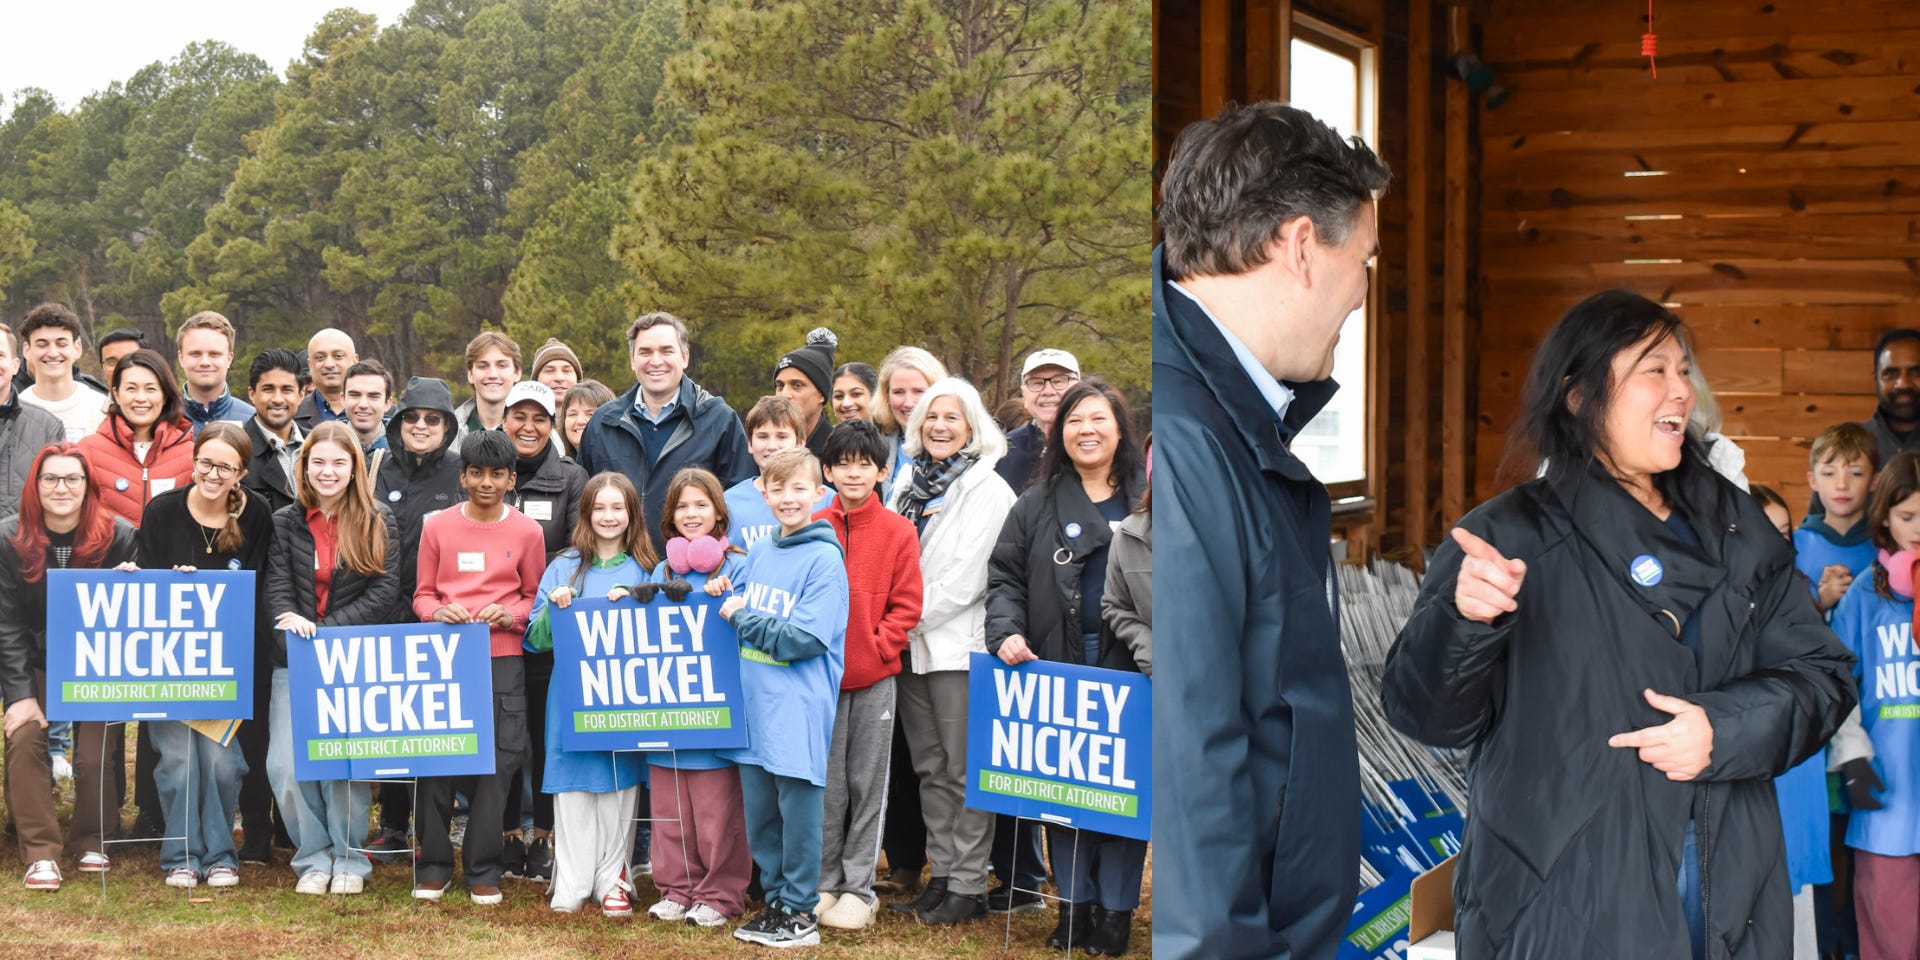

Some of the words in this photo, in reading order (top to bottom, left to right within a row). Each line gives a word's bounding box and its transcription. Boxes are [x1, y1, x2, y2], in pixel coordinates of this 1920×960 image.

[75, 583, 226, 628] WILEY
[574, 604, 708, 657] WILEY
[75, 631, 234, 677] NICKEL
[313, 633, 461, 685] WILEY
[73, 684, 99, 699] FOR
[102, 683, 158, 699] DISTRICT
[160, 683, 226, 698] ATTORNEY
[580, 655, 726, 706] NICKEL
[993, 668, 1130, 734] WILEY
[316, 682, 474, 734] NICKEL
[584, 714, 607, 729] FOR
[609, 712, 657, 728] DISTRICT
[660, 710, 720, 727] ATTORNEY
[319, 741, 342, 757] FOR
[346, 739, 398, 755] DISTRICT
[401, 736, 467, 754] ATTORNEY
[991, 718, 1136, 790] NICKEL
[989, 773, 1011, 791] FOR
[1014, 777, 1064, 800] DISTRICT
[1066, 787, 1128, 812] ATTORNEY
[1366, 907, 1408, 942] DISTRICT
